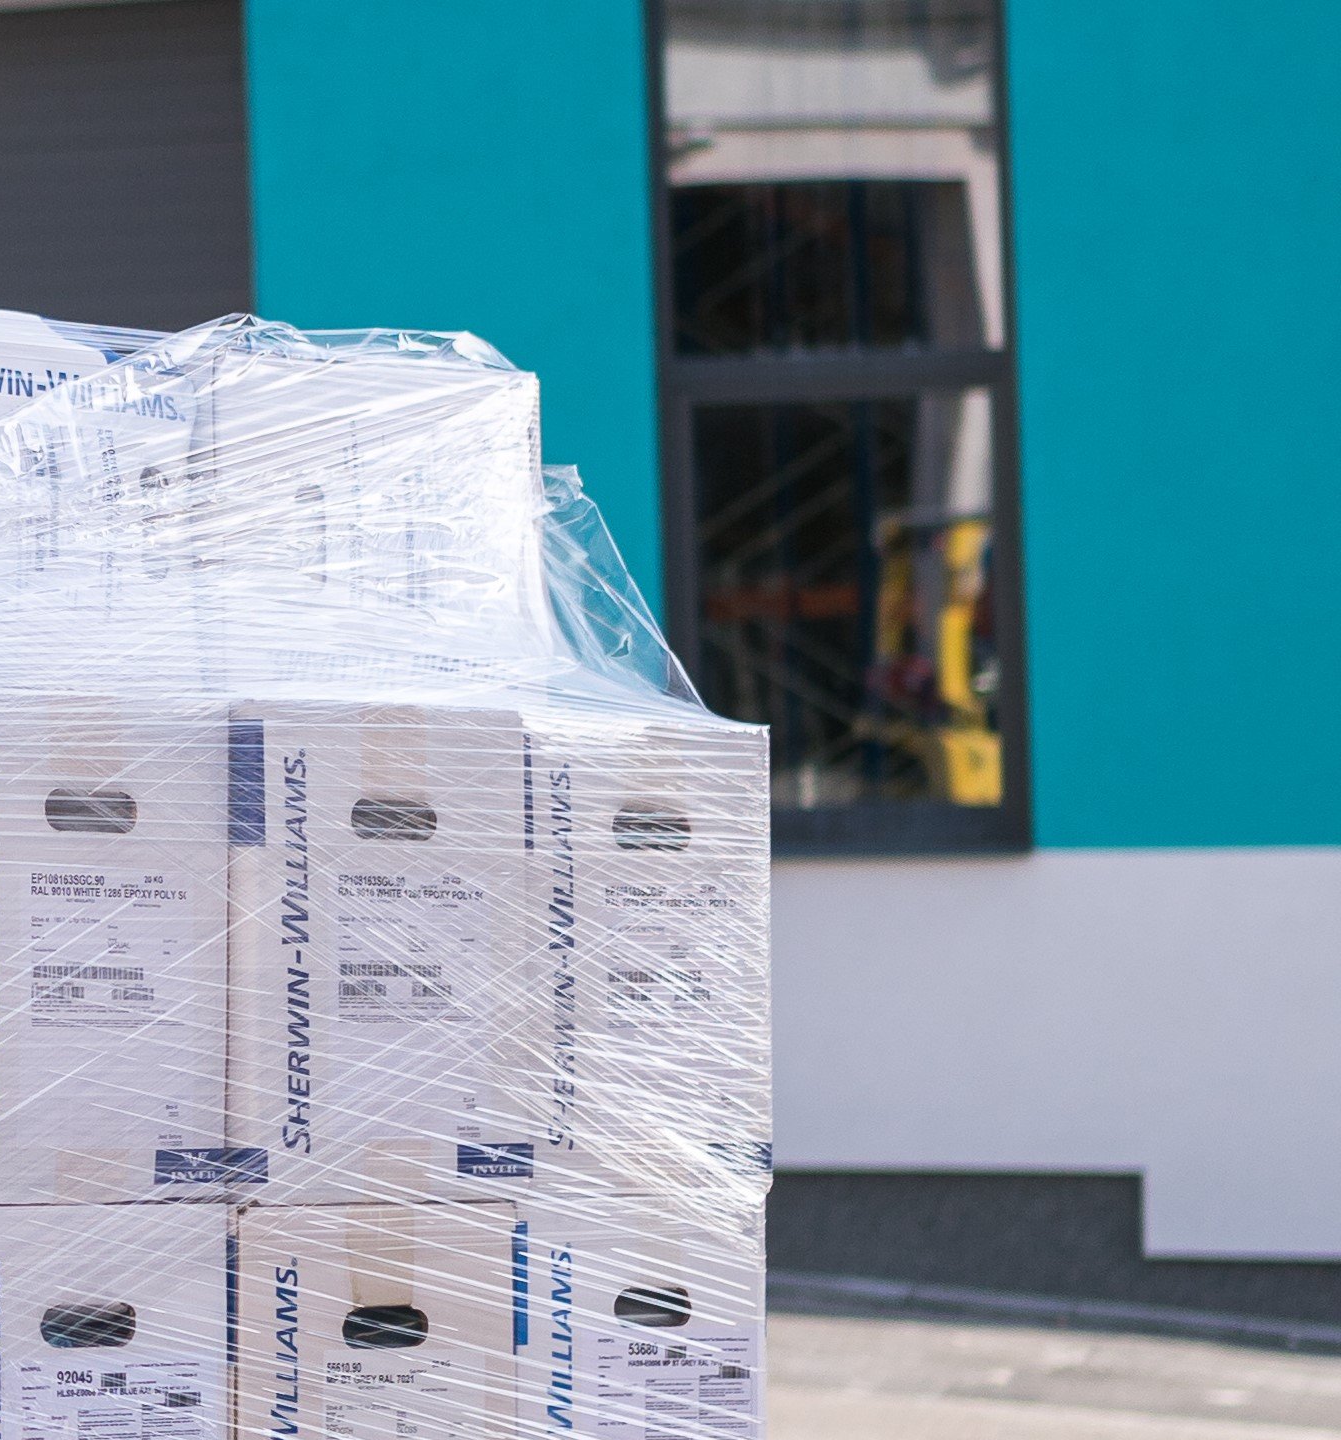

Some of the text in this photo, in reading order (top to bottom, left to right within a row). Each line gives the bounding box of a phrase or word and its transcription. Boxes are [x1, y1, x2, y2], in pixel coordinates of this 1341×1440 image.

[153, 876, 163, 884] KG
[31, 886, 49, 896] RAL
[52, 887, 71, 896] 9010
[73, 888, 101, 898] WHITE
[124, 889, 152, 899] EPOXY
[154, 890, 176, 900] POLY
[376, 888, 402, 898] WHITE
[423, 889, 450, 899] EPOXY
[628, 1342, 659, 1356] 53680
[56, 1370, 93, 1385] 92045
[378, 1375, 395, 1384] RAL
[397, 1375, 415, 1384] 7021
